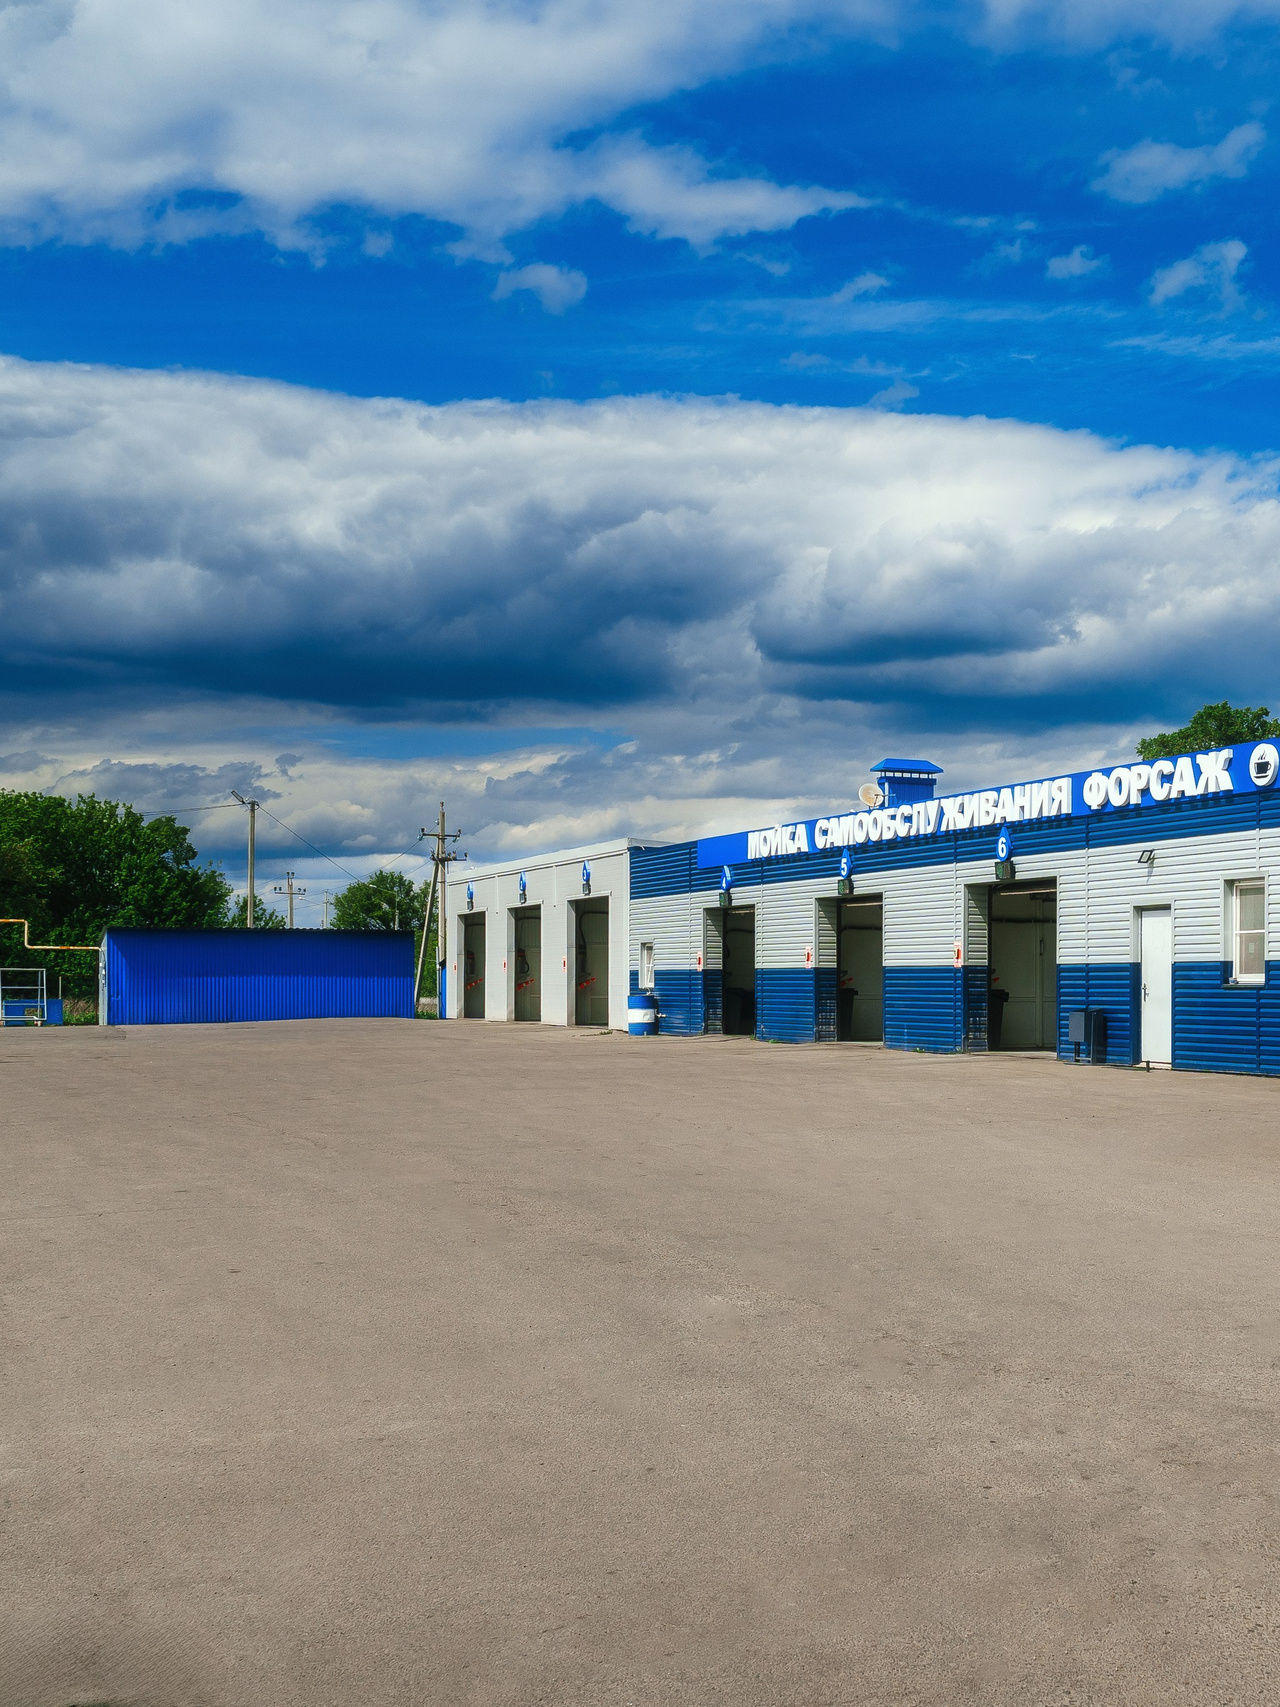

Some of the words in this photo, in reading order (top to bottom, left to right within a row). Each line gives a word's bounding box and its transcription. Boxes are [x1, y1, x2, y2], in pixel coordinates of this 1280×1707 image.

[747, 823, 809, 860] МОЙКА
[814, 777, 1072, 850] САМООБСЛУЖИВАНИЯ
[1083, 748, 1234, 810] ФОРСАЖ
[998, 836, 1007, 858] 6
[840, 858, 847, 876] 5
[721, 877, 727, 890] 4
